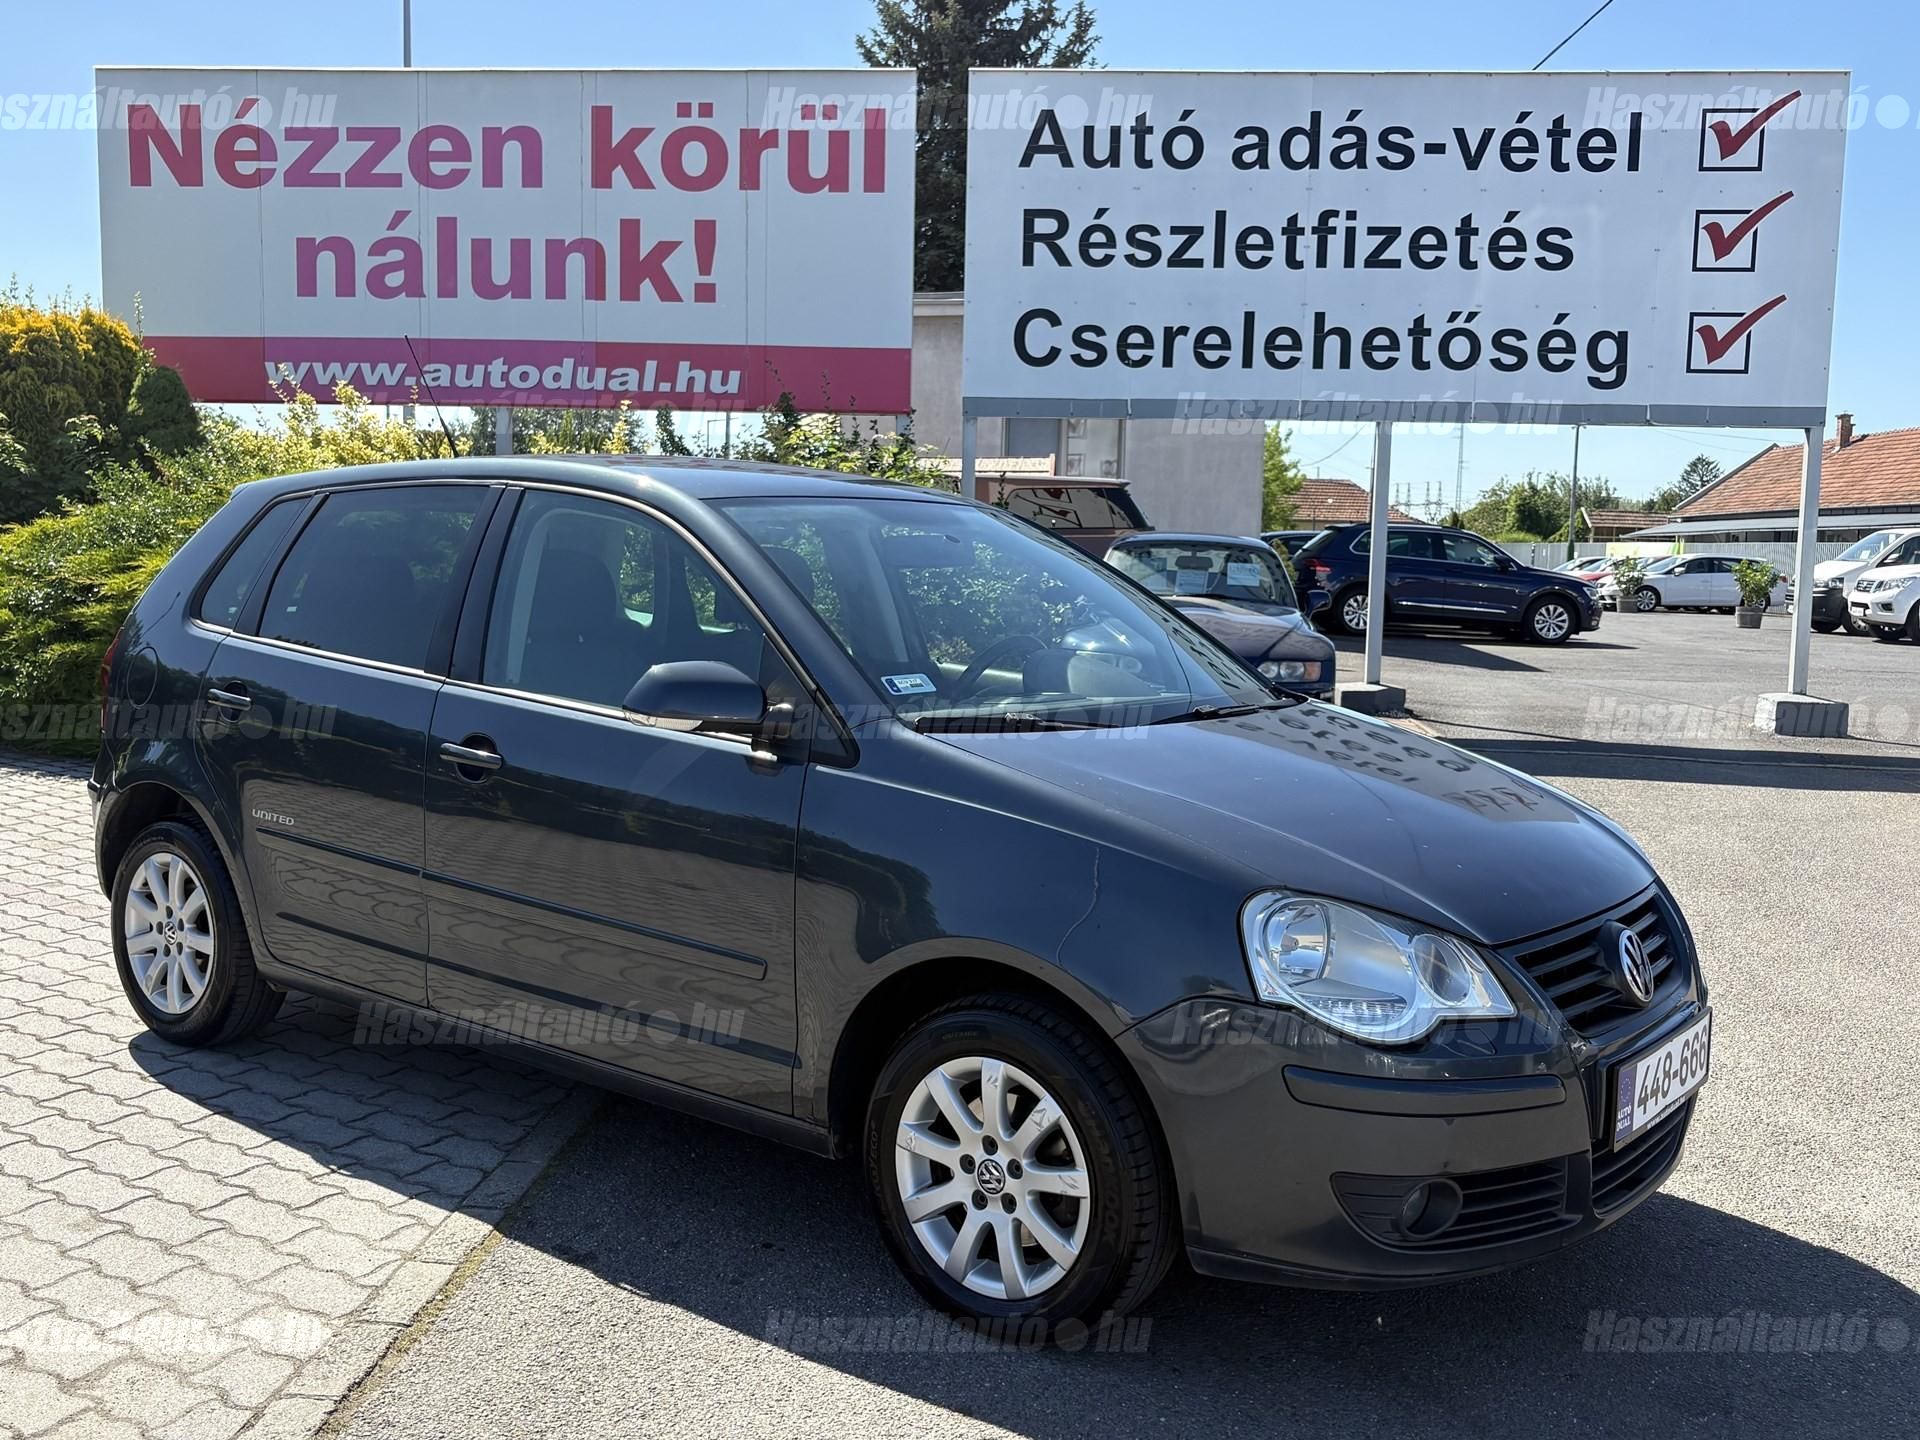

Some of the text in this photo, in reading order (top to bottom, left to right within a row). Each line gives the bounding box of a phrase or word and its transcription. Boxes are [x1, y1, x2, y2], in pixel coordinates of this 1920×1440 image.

[127, 98, 887, 194] Nézzen körül
[1018, 109, 1642, 173] Autó adás-vétel
[295, 210, 717, 303] nálunk!
[1021, 207, 1575, 271] Részletfizetés
[264, 356, 742, 394] www.autodual.hu
[1013, 307, 1629, 389] Cserelehetőség
[1636, 1024, 1708, 1115] 448-666
